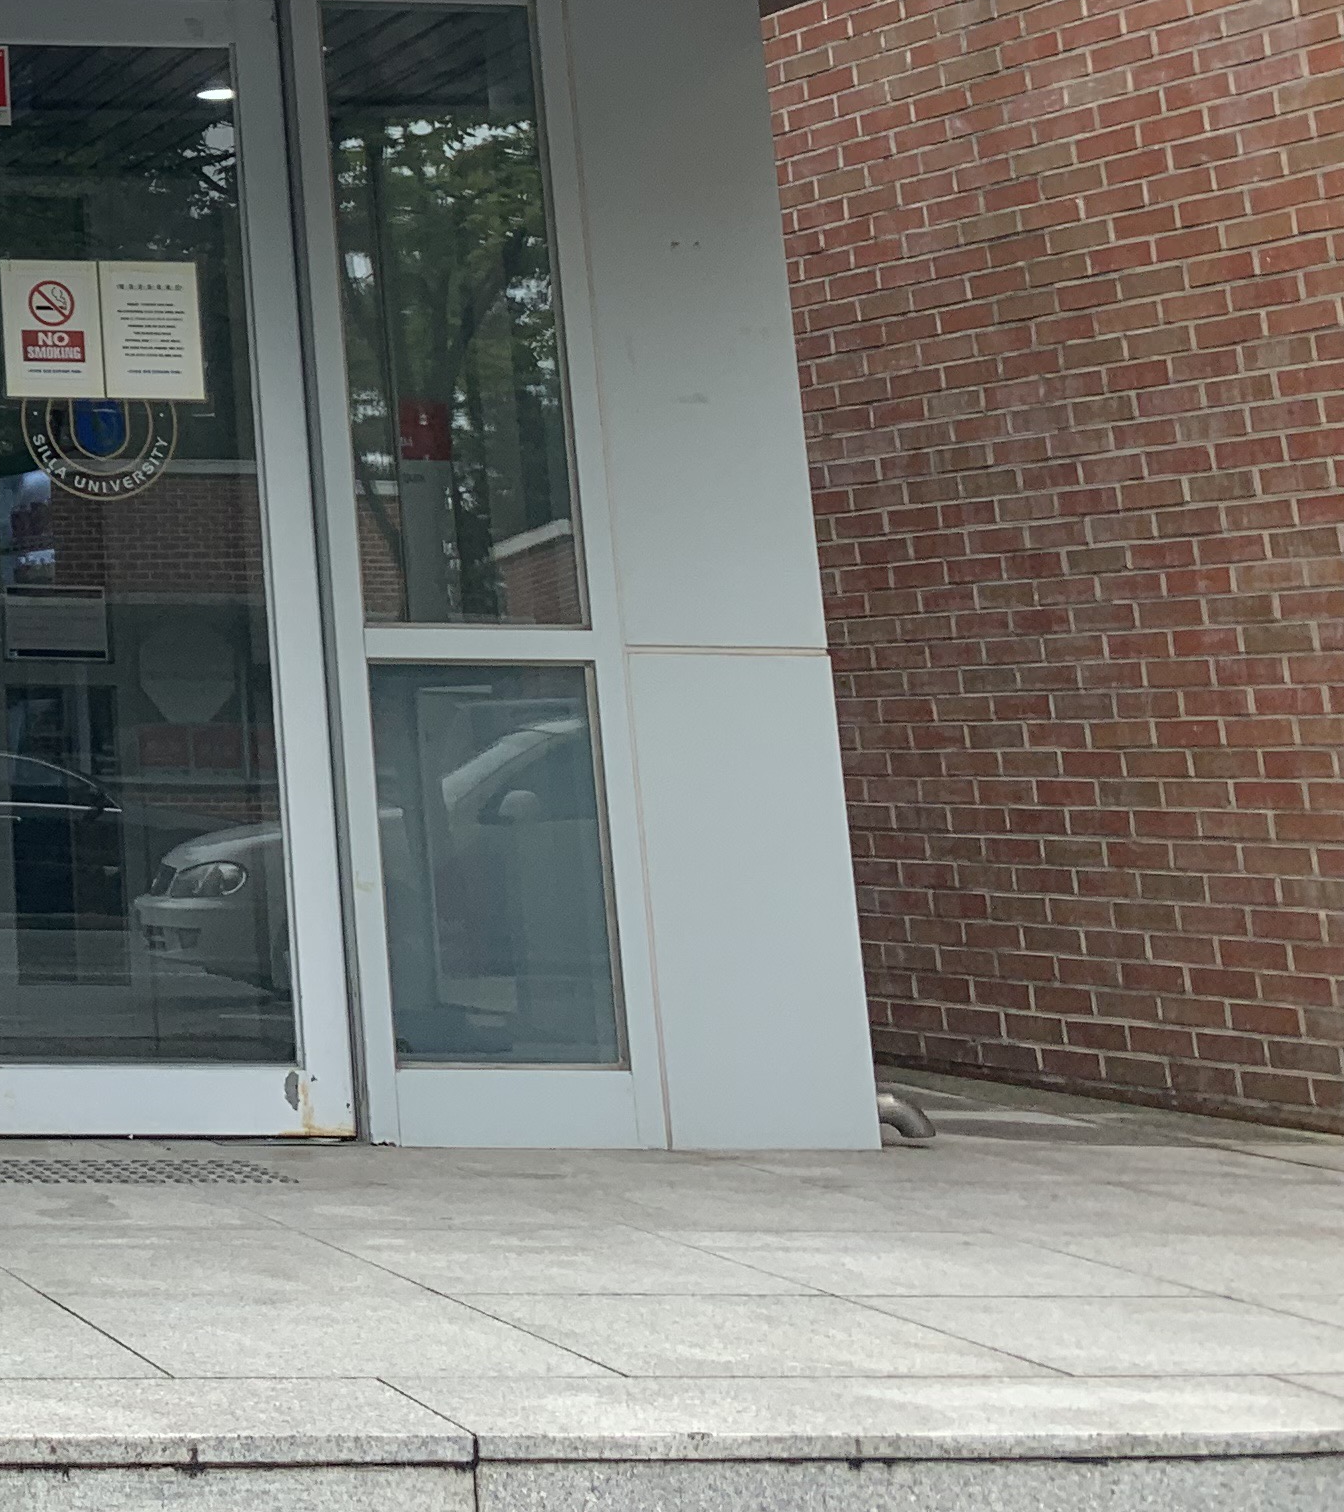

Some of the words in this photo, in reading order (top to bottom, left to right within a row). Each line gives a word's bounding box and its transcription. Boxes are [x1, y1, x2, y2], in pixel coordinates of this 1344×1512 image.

[37, 332, 69, 346] NO
[27, 346, 82, 360] SMOKING
[32, 433, 67, 480] SILLA
[74, 436, 169, 494] UNIVERSITY
